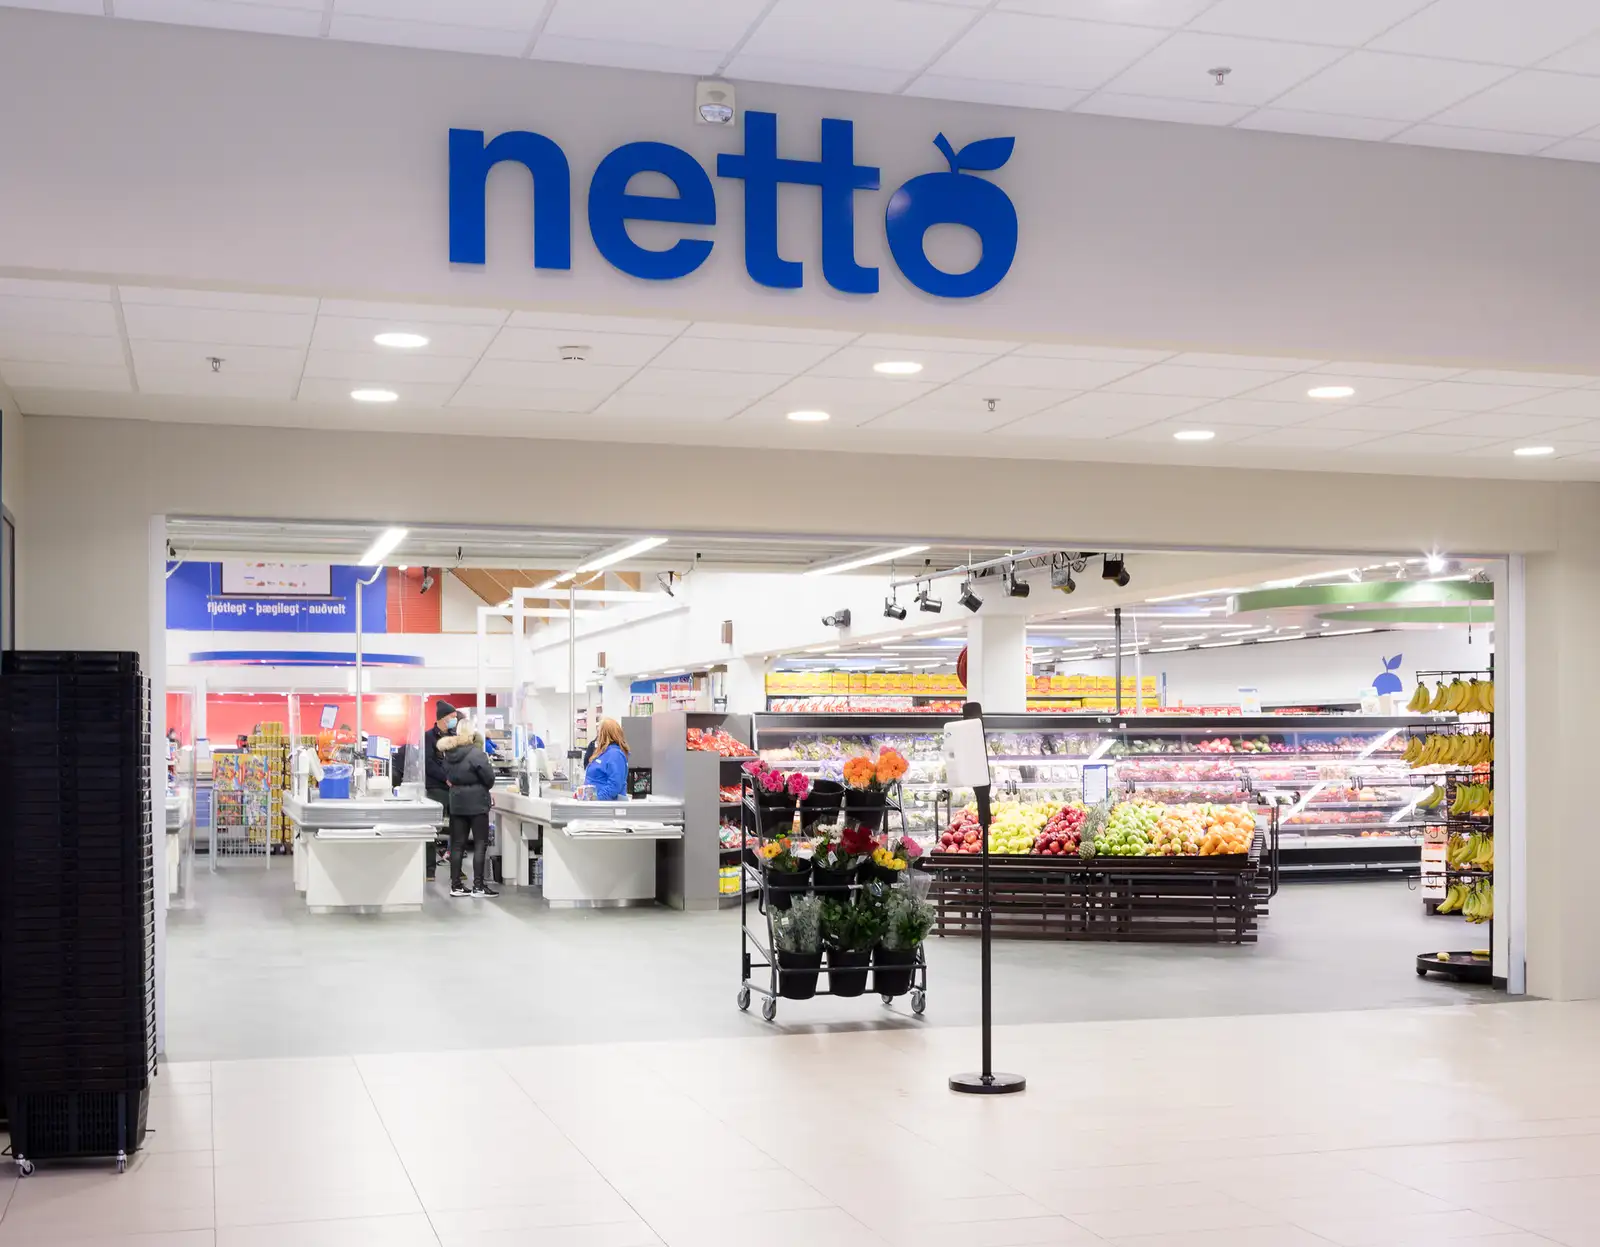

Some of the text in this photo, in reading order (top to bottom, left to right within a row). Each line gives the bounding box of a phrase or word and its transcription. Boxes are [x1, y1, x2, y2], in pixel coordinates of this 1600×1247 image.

[449, 111, 1018, 299] netto
[207, 602, 247, 615] fljótlegt
[256, 602, 299, 616] þægilegt
[309, 603, 346, 614] auðvelt
